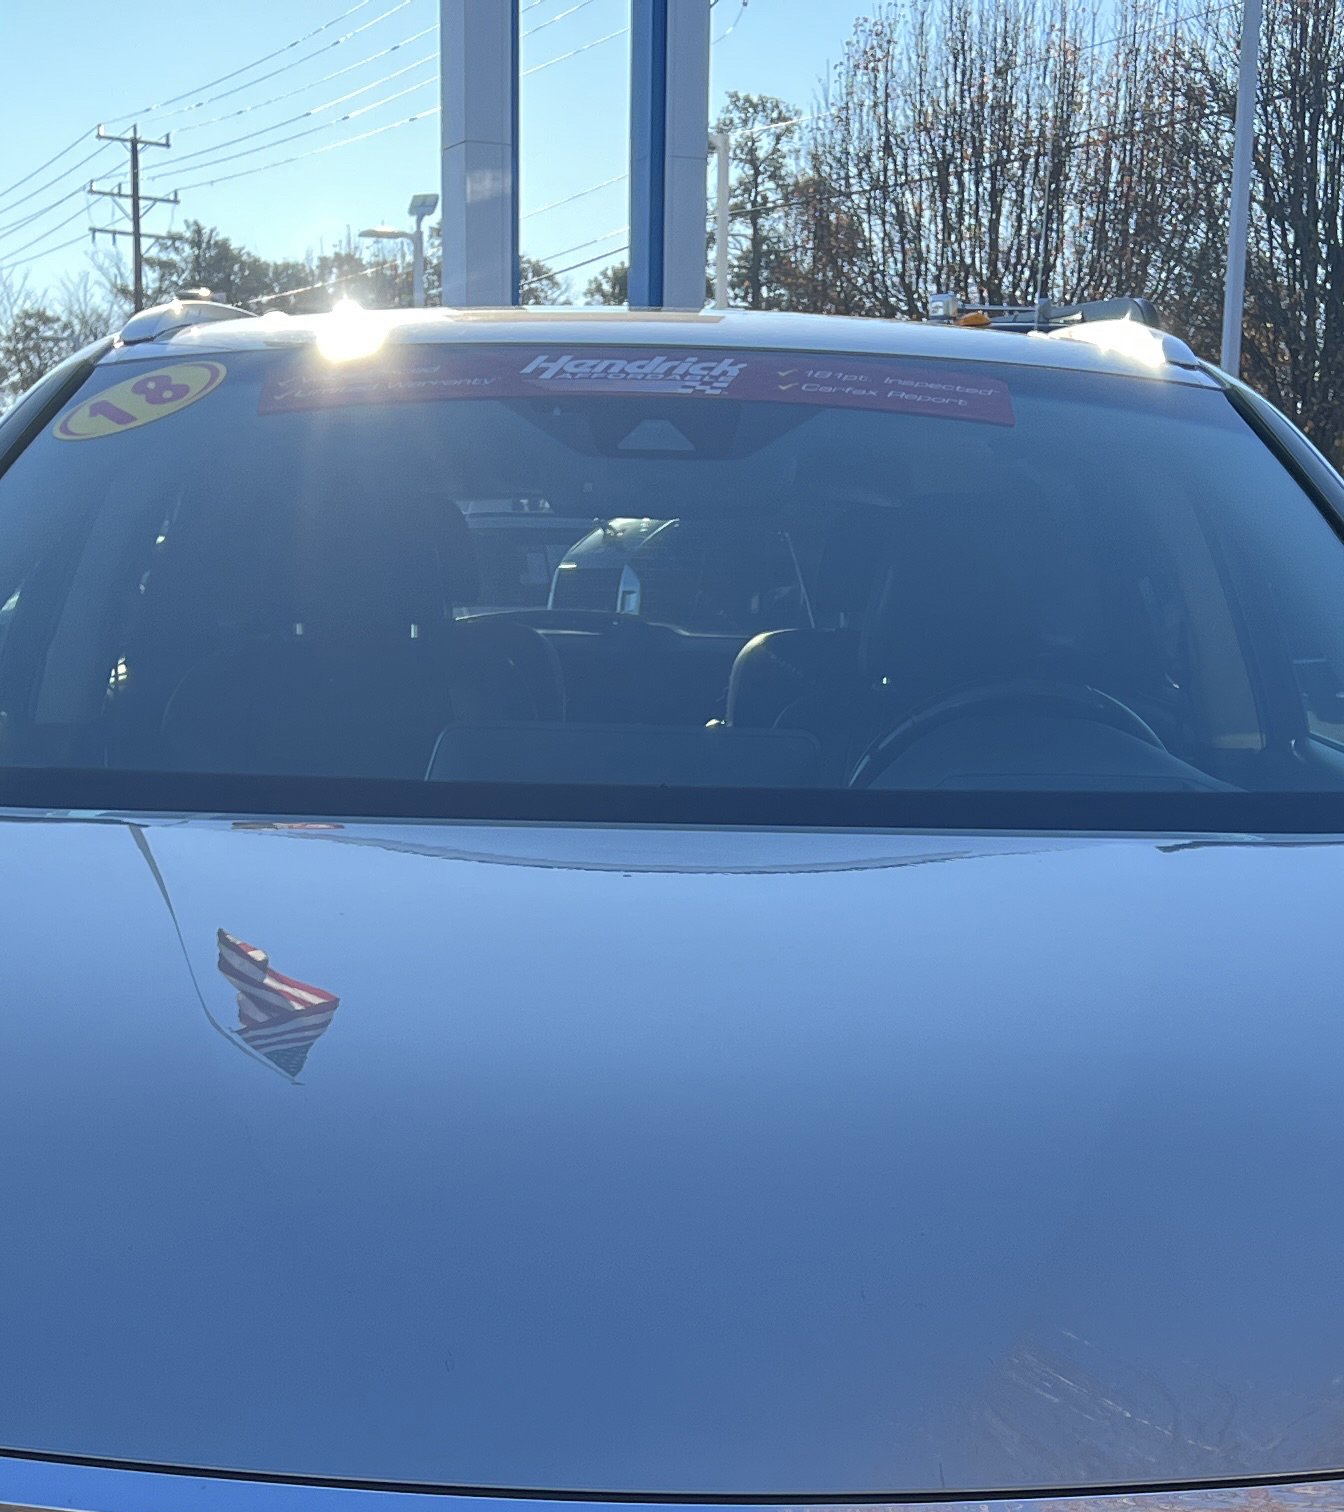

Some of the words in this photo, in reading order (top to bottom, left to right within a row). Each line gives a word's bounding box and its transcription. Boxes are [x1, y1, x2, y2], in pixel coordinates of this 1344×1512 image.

[519, 354, 748, 380] Hendrick
[88, 374, 191, 426] 18
[887, 390, 969, 407] Report
